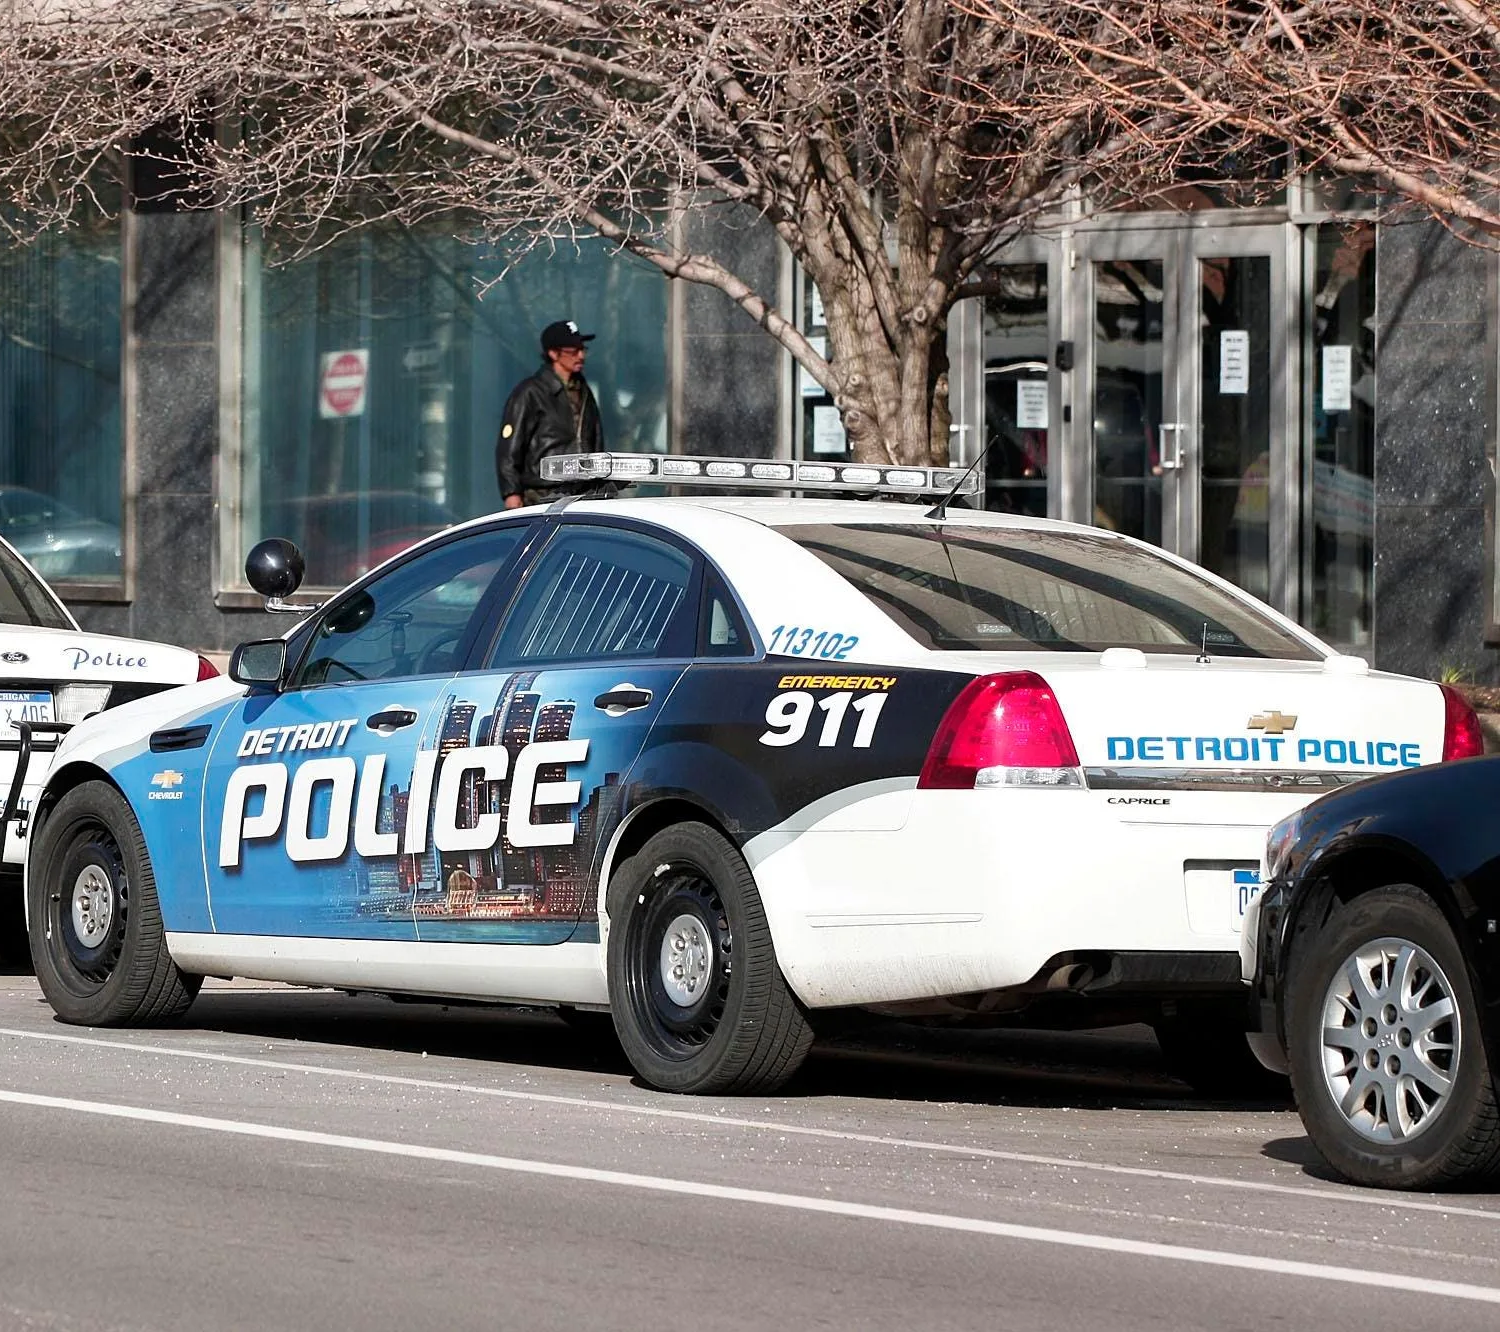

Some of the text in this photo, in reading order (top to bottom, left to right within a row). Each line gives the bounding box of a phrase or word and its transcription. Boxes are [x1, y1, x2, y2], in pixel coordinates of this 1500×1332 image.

[768, 625, 859, 660] 113102
[63, 647, 148, 670] Police
[777, 675, 897, 690] EMERGENCY
[758, 690, 889, 749] 911
[236, 719, 359, 757] DETROIT
[1106, 736, 1422, 767] DETROIT POLICE
[148, 791, 184, 800] CHEVROLET
[218, 738, 591, 868] POLICE
[1107, 797, 1171, 805] CAPRICE
